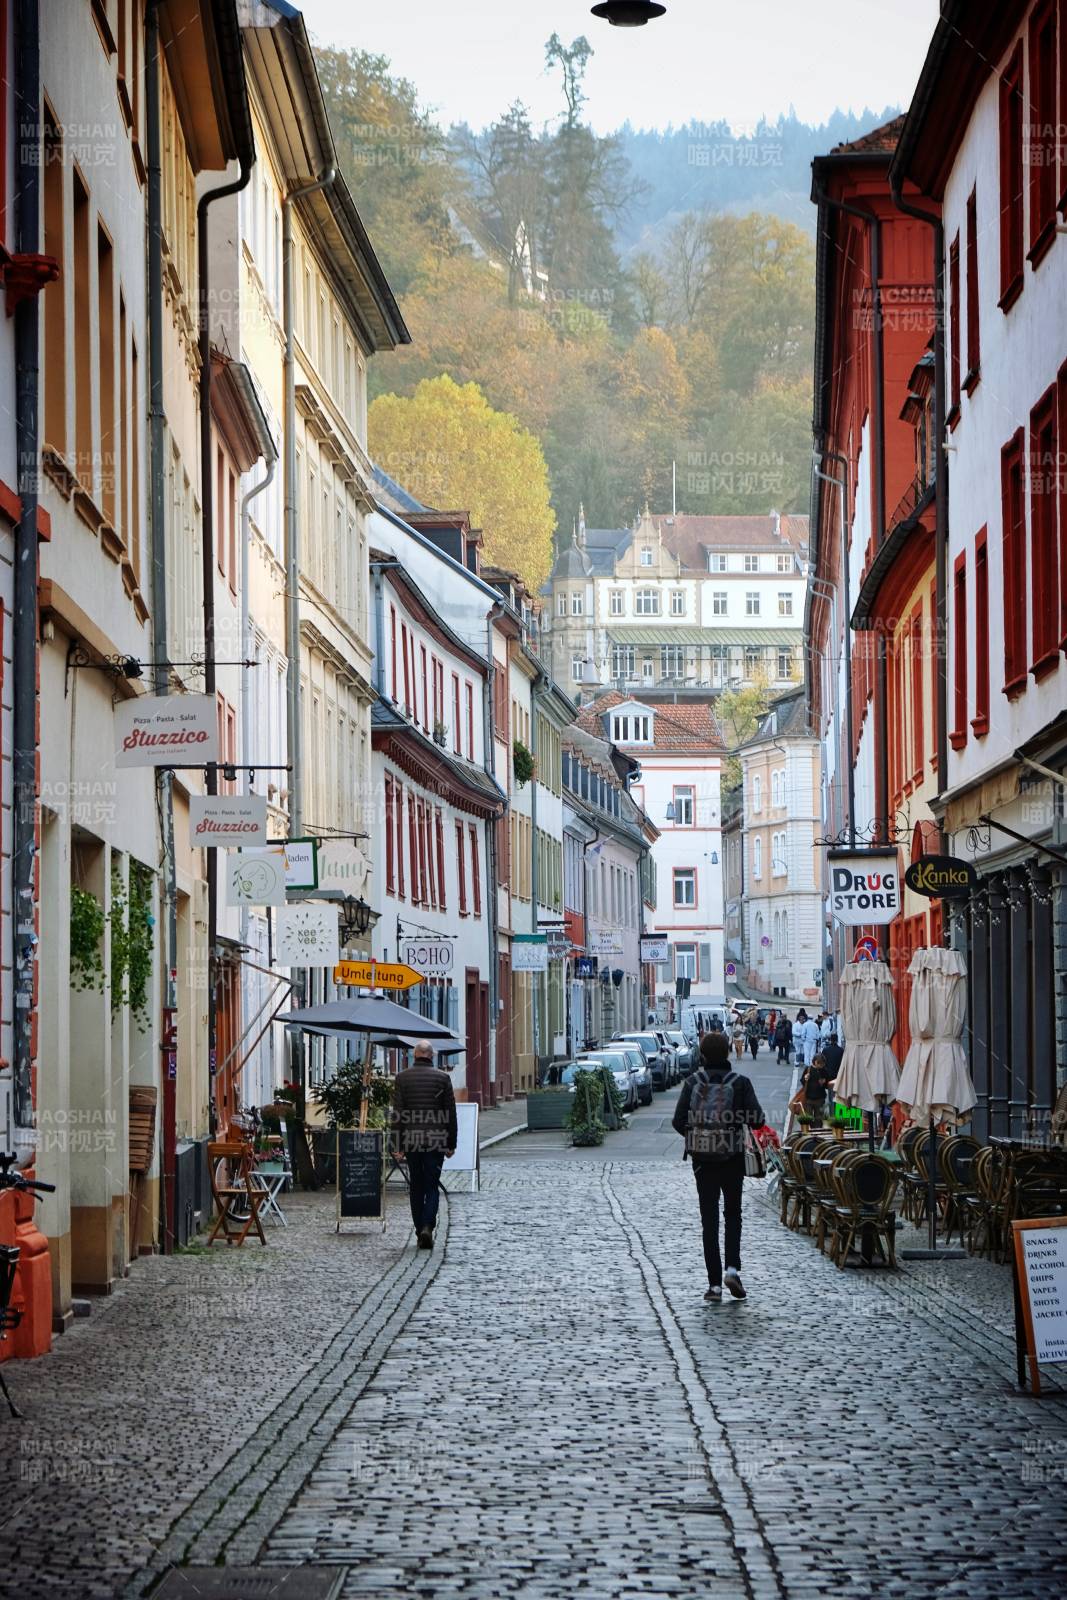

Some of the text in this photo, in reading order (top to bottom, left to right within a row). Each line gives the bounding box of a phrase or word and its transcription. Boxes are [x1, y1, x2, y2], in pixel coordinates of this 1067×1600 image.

[180, 713, 197, 721] Salat
[123, 728, 210, 752] Stuzzico
[195, 816, 260, 836] Stuzzico
[833, 868, 895, 892] DRUG
[911, 863, 969, 892] Kanka
[834, 893, 896, 911] STORE
[406, 947, 450, 965] BOHO
[341, 967, 404, 985] Umleitung
[1026, 1237, 1058, 1246] SNACKS
[1027, 1250, 1057, 1259] DRINKS
[1029, 1261, 1066, 1270] ALCOHOL
[1030, 1274, 1054, 1283] CHIPS
[1032, 1286, 1057, 1295] VAPES
[1033, 1298, 1060, 1307] SHOTS
